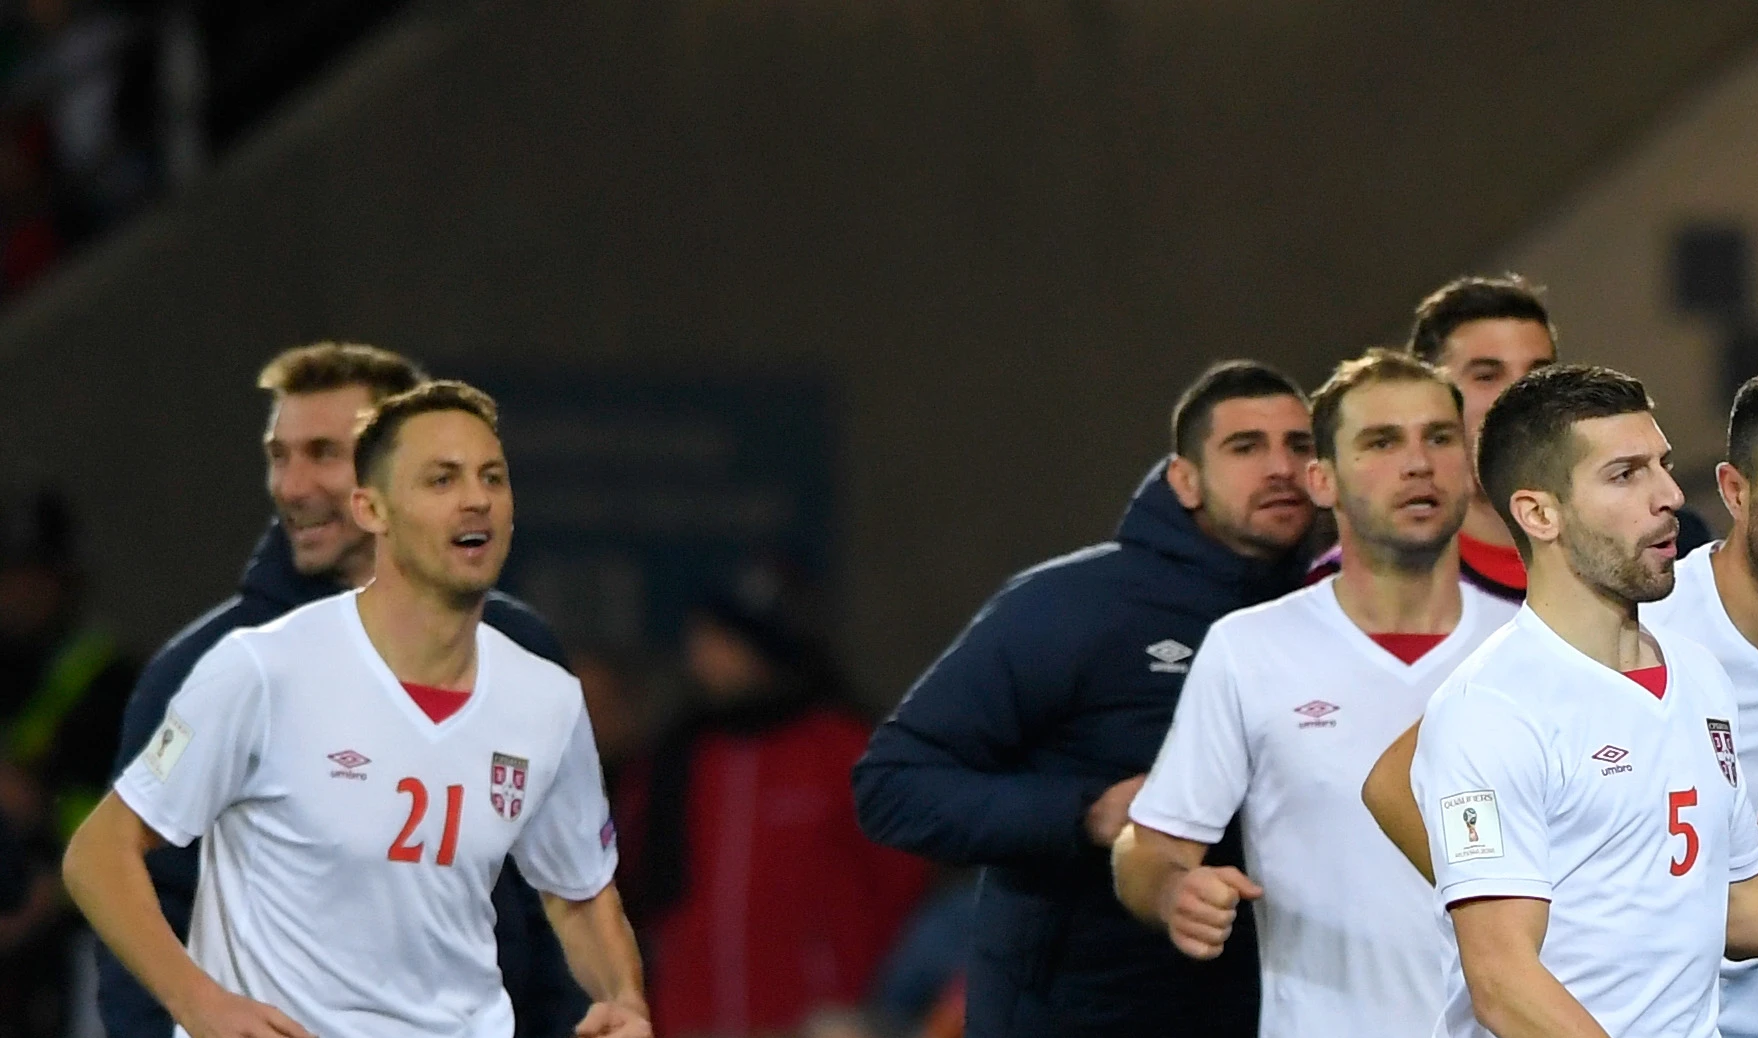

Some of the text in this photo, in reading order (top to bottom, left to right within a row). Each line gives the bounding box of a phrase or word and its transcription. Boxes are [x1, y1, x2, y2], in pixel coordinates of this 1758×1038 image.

[1600, 763, 1633, 777] umbro
[387, 775, 465, 867] 21
[1668, 784, 1699, 877] 5
